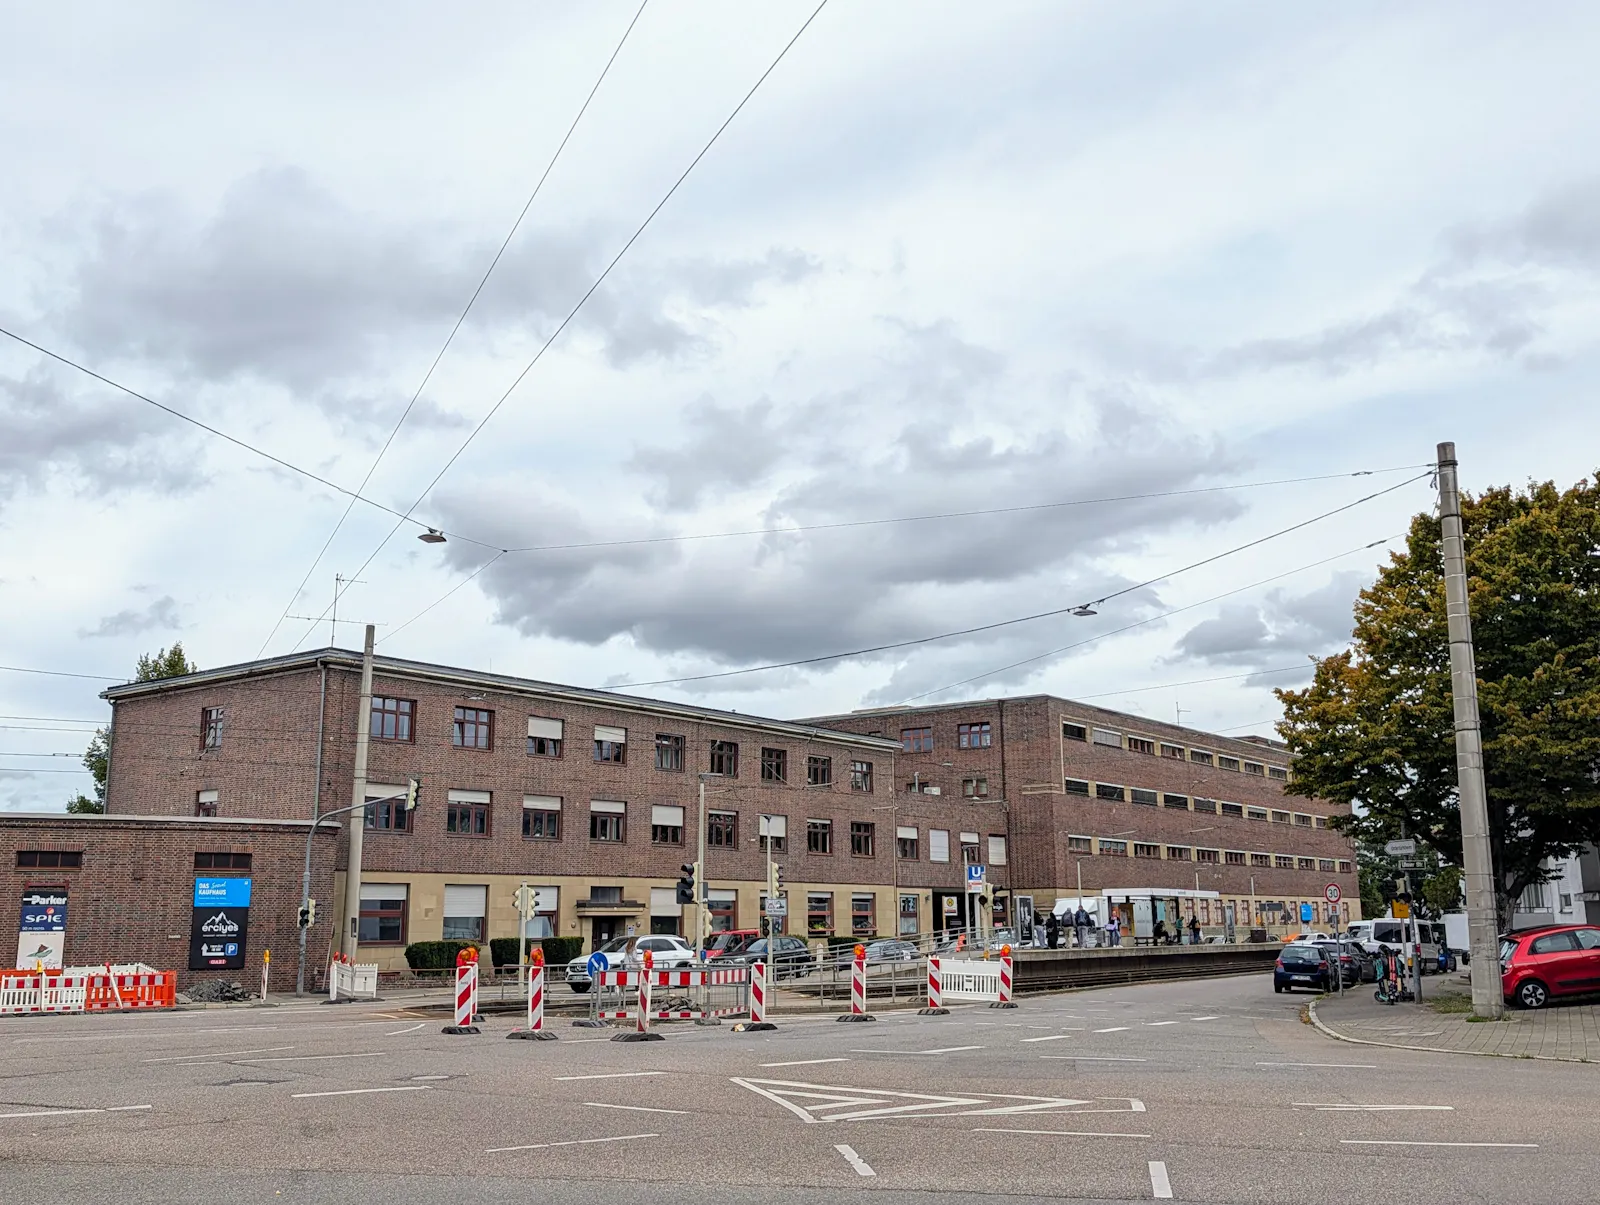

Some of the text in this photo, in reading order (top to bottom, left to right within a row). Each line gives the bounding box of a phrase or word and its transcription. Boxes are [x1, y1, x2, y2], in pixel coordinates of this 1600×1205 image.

[971, 866, 981, 877] U
[1328, 888, 1338, 898] 30
[30, 894, 67, 905] Parker
[25, 914, 62, 922] SPIE
[202, 923, 238, 934] erciyes
[228, 944, 236, 954] P
